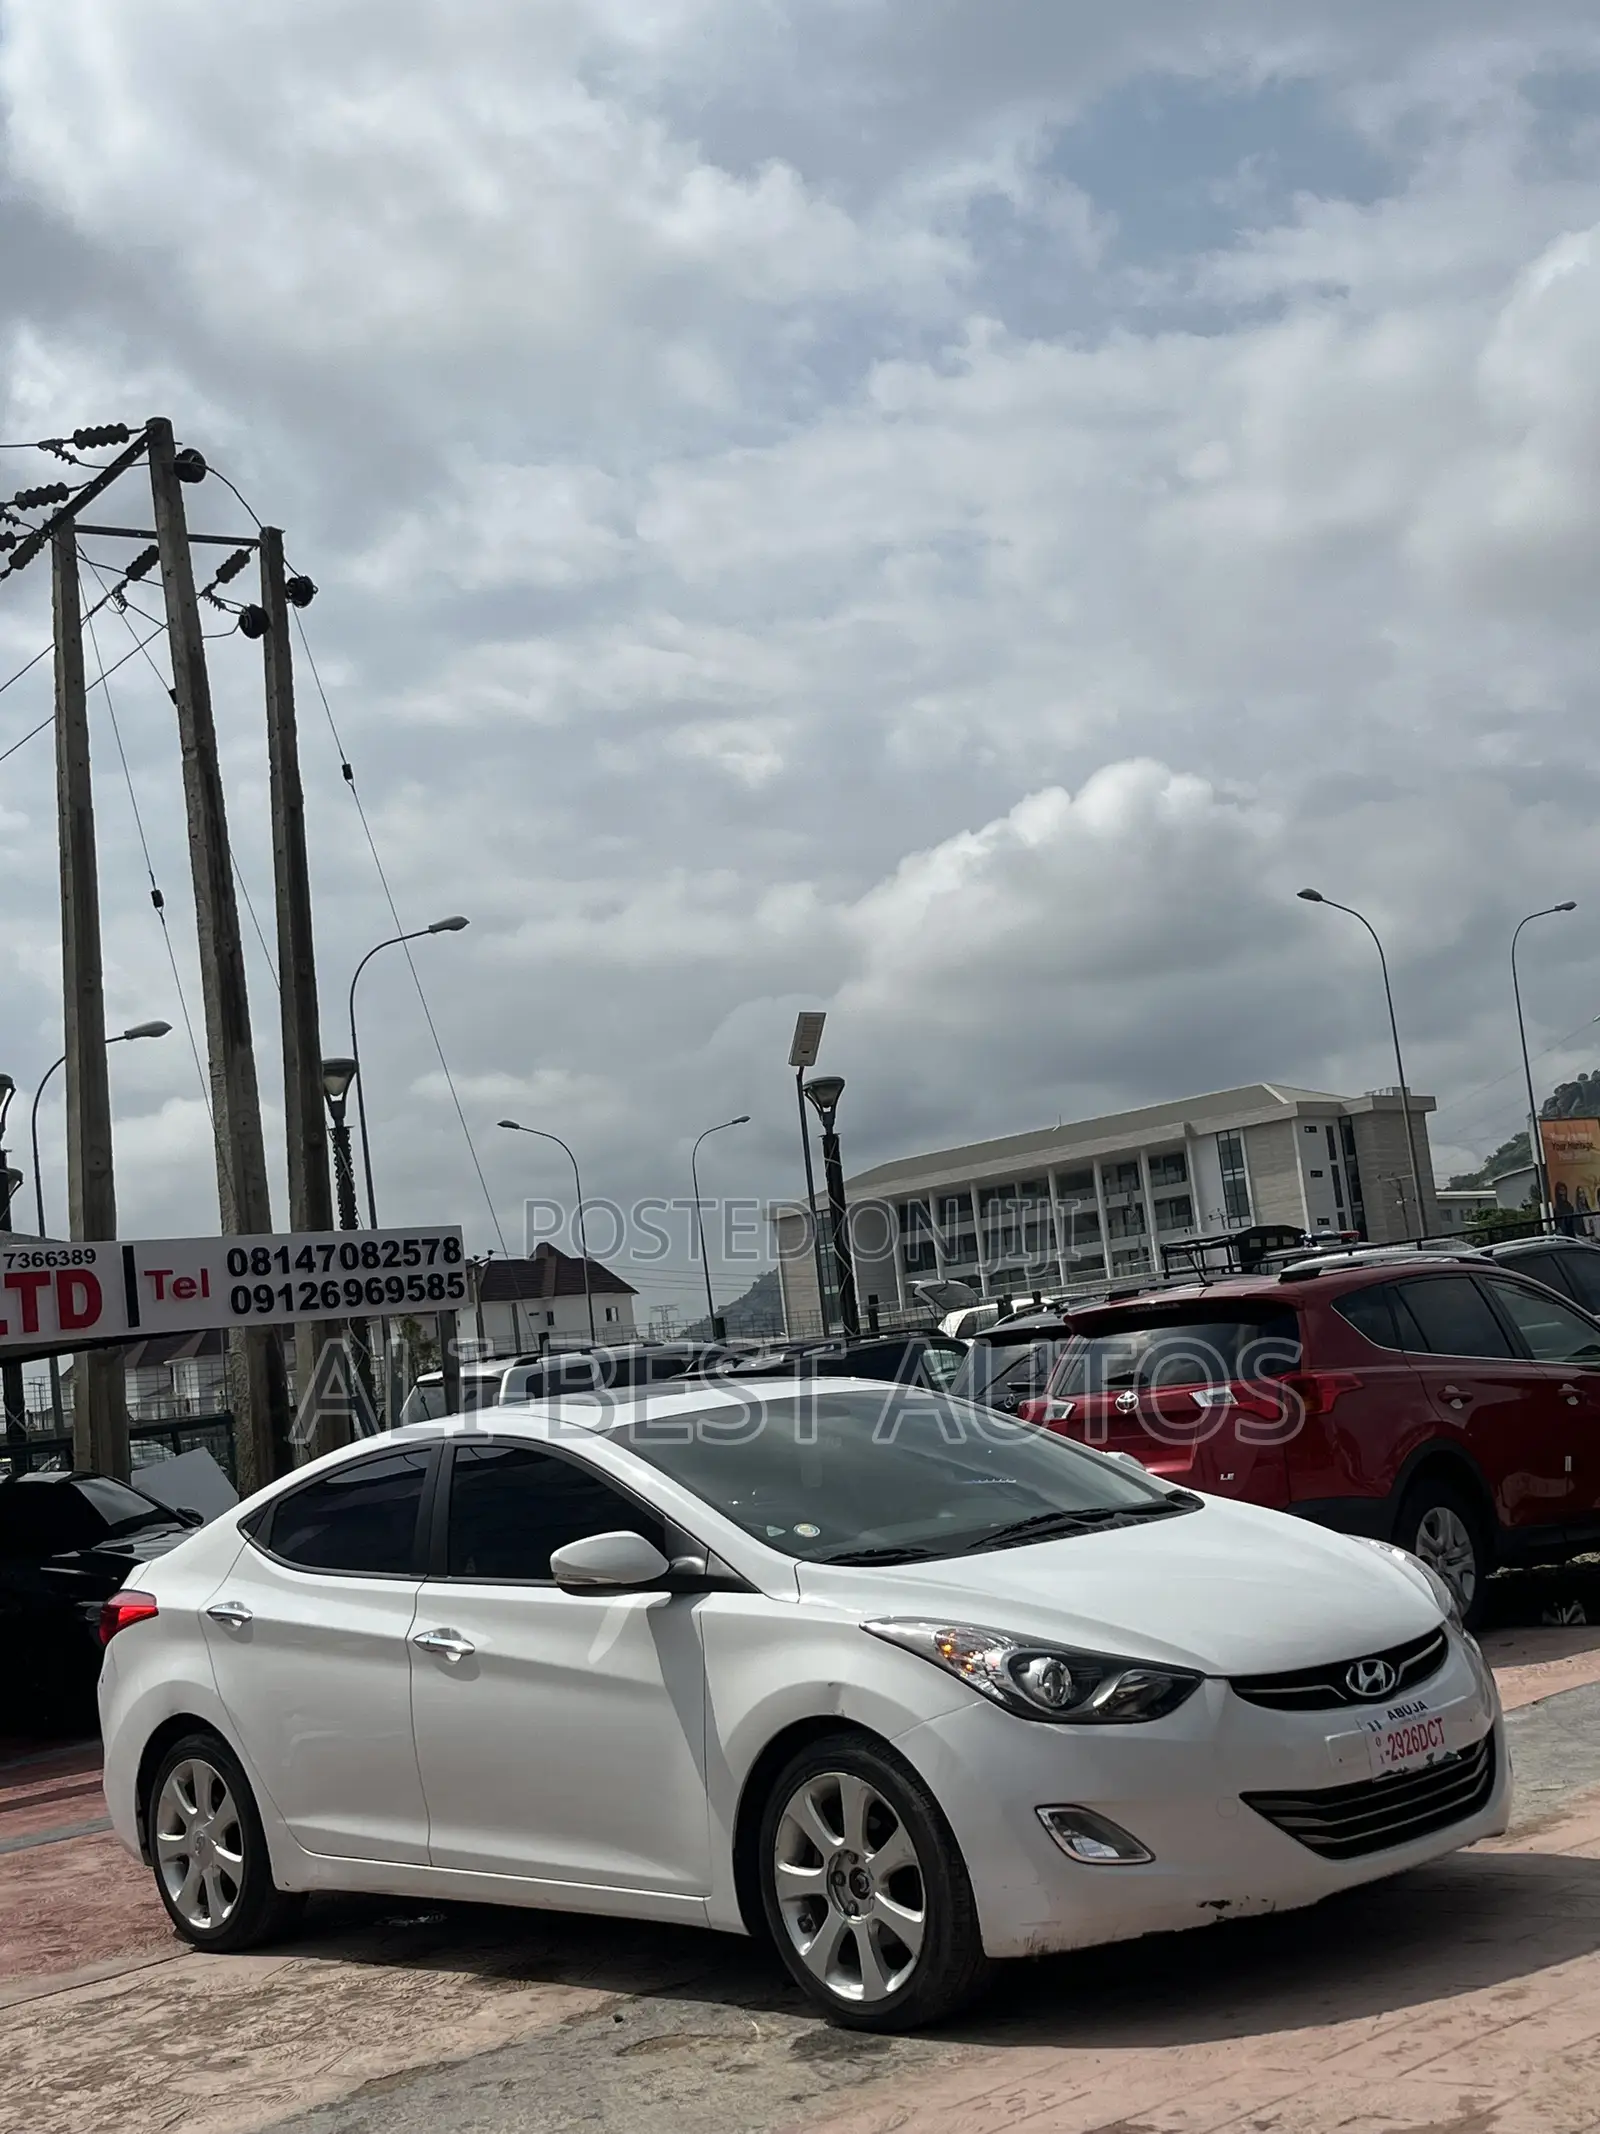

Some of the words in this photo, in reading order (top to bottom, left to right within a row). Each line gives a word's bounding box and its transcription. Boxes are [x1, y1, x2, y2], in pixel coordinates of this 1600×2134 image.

[4, 1248, 97, 1269] 7366389
[226, 1236, 462, 1277] 08147082578
[0, 1268, 103, 1335] TD
[143, 1268, 210, 1300] Tel
[230, 1271, 465, 1315] 09126969585
[1386, 1700, 1429, 1721] ABUJA
